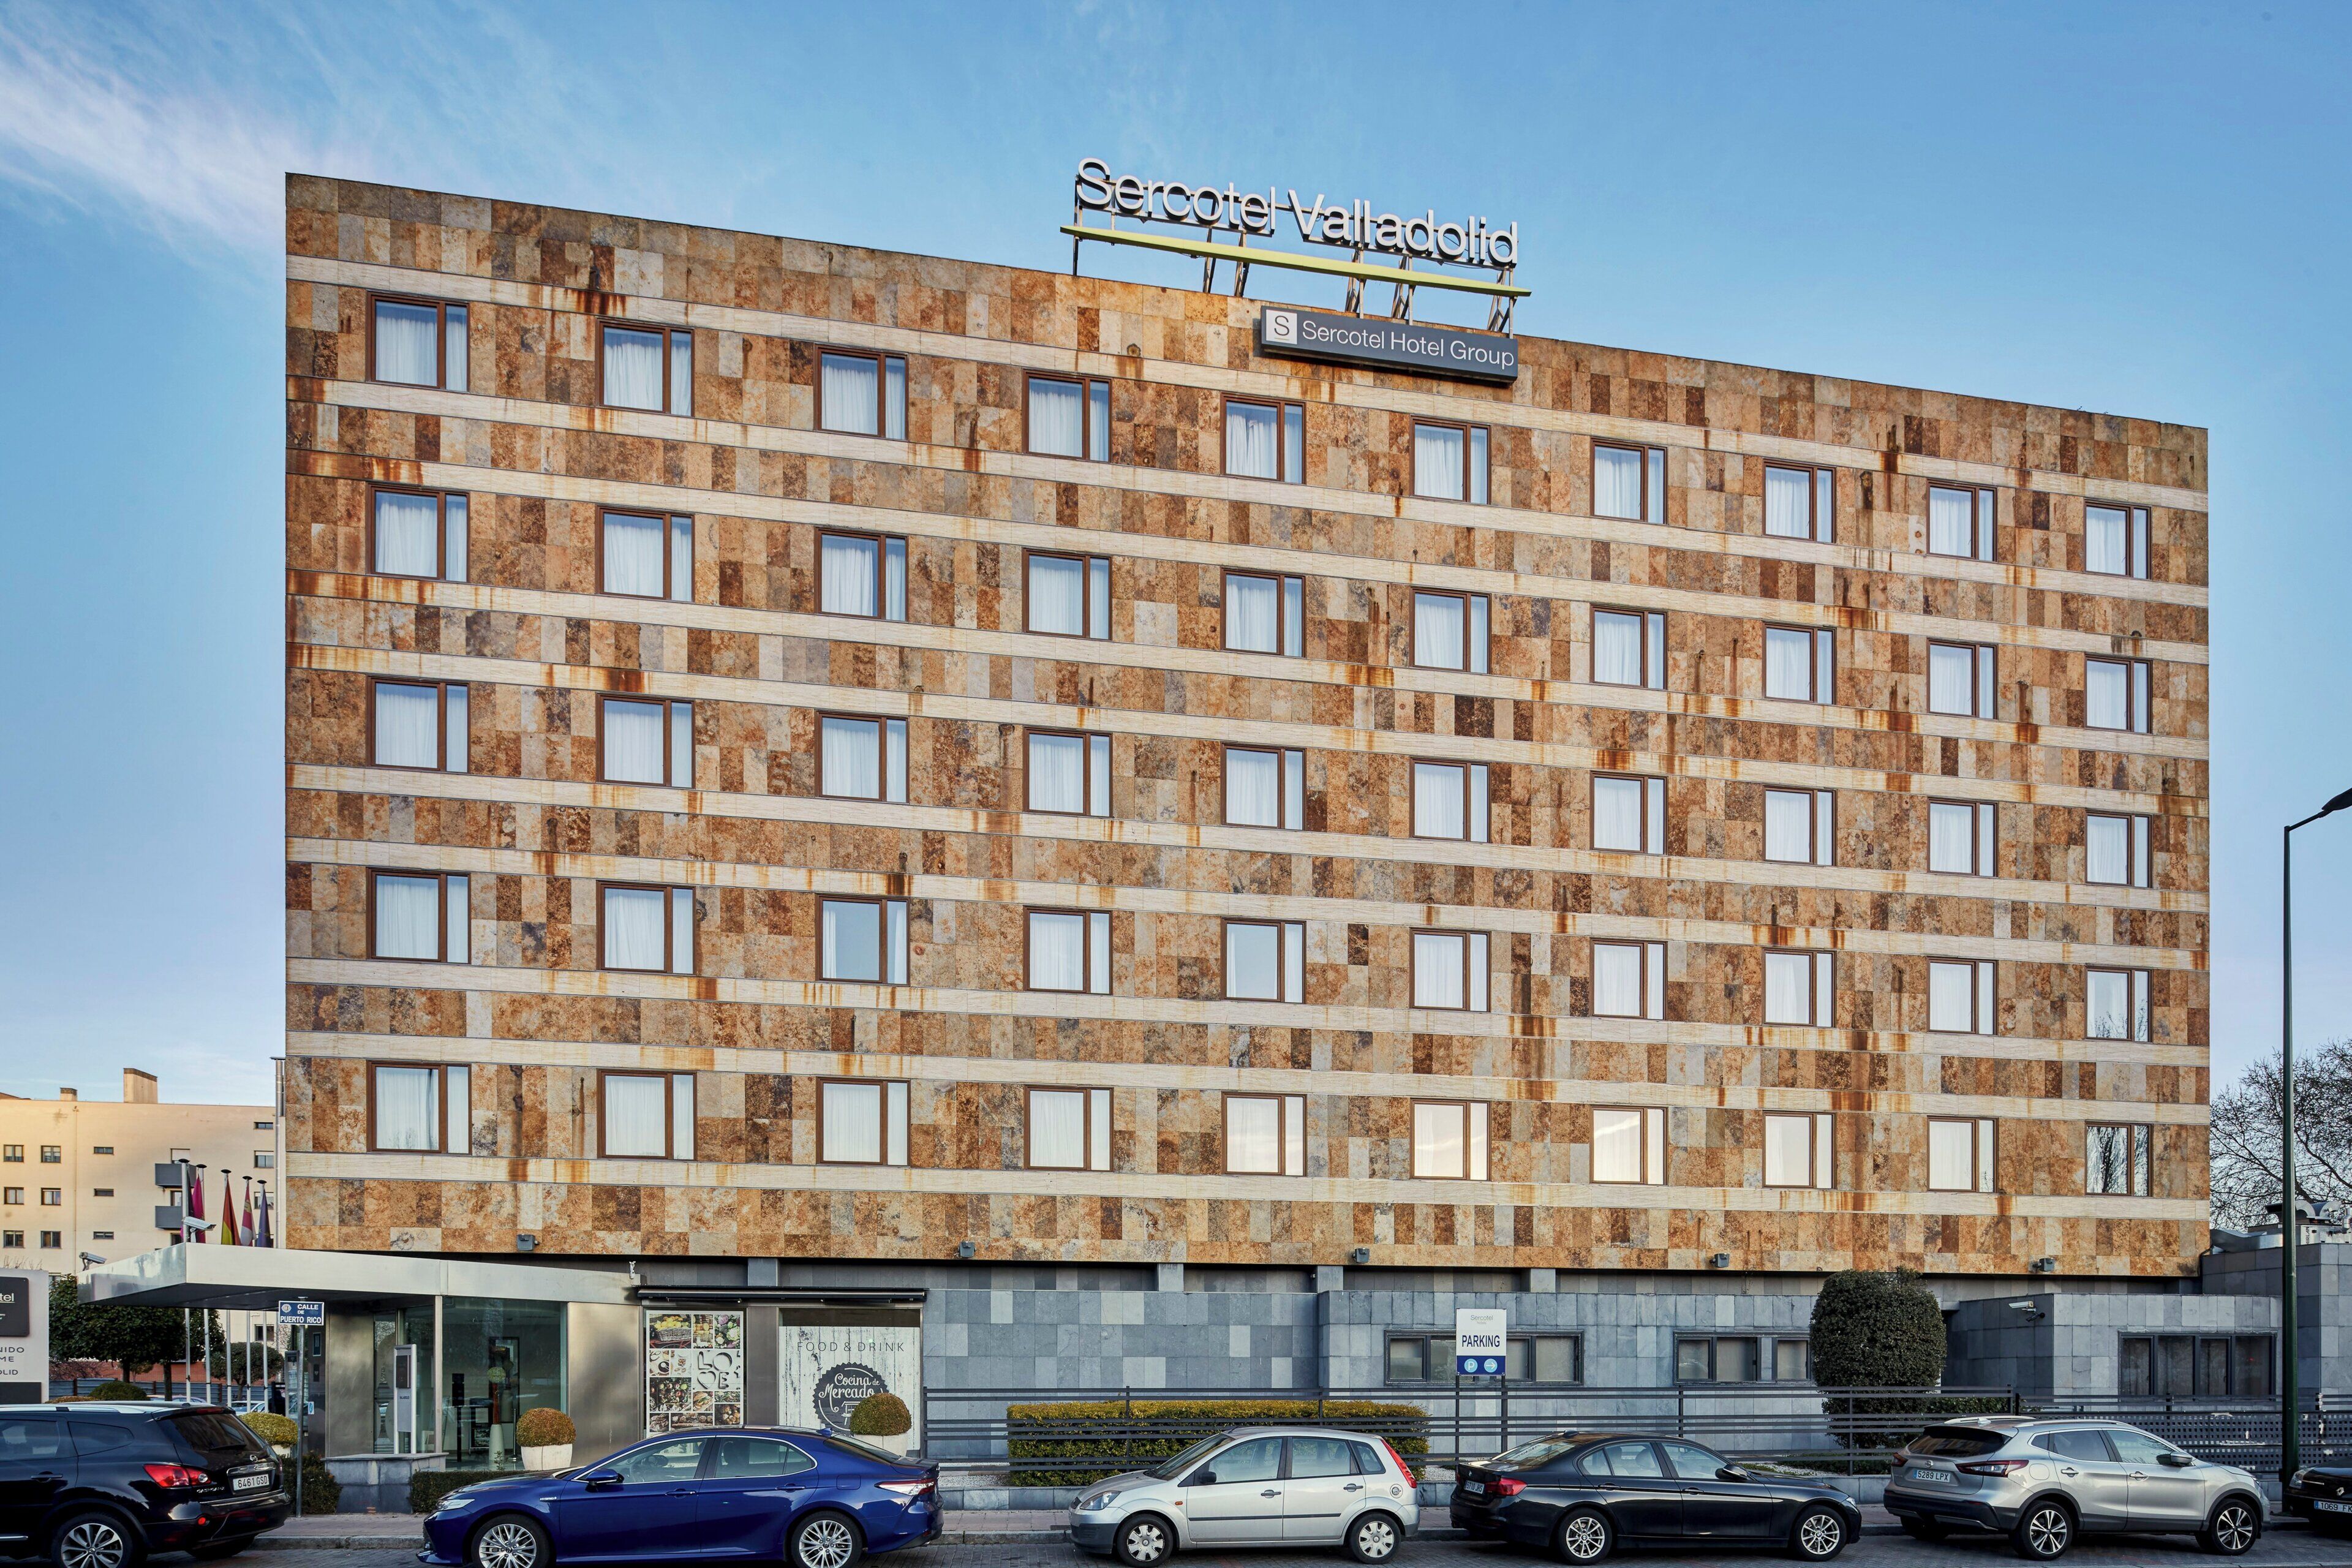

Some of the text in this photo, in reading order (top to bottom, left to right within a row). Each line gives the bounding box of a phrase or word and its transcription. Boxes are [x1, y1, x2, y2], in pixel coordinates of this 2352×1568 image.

[1076, 157, 1518, 267] Sercotel Valladolid
[1302, 320, 1514, 370] Sercotel Hotel Group
[797, 1342, 904, 1352] FOOD & DRINK
[1462, 1335, 1500, 1348] PARKING
[834, 1373, 872, 1385] Cocina
[818, 1383, 875, 1413] Mercado
[238, 1476, 268, 1488] 6461 GSD
[1918, 1471, 1949, 1481] 5289 LPX
[2321, 1502, 2339, 1511] 1069
